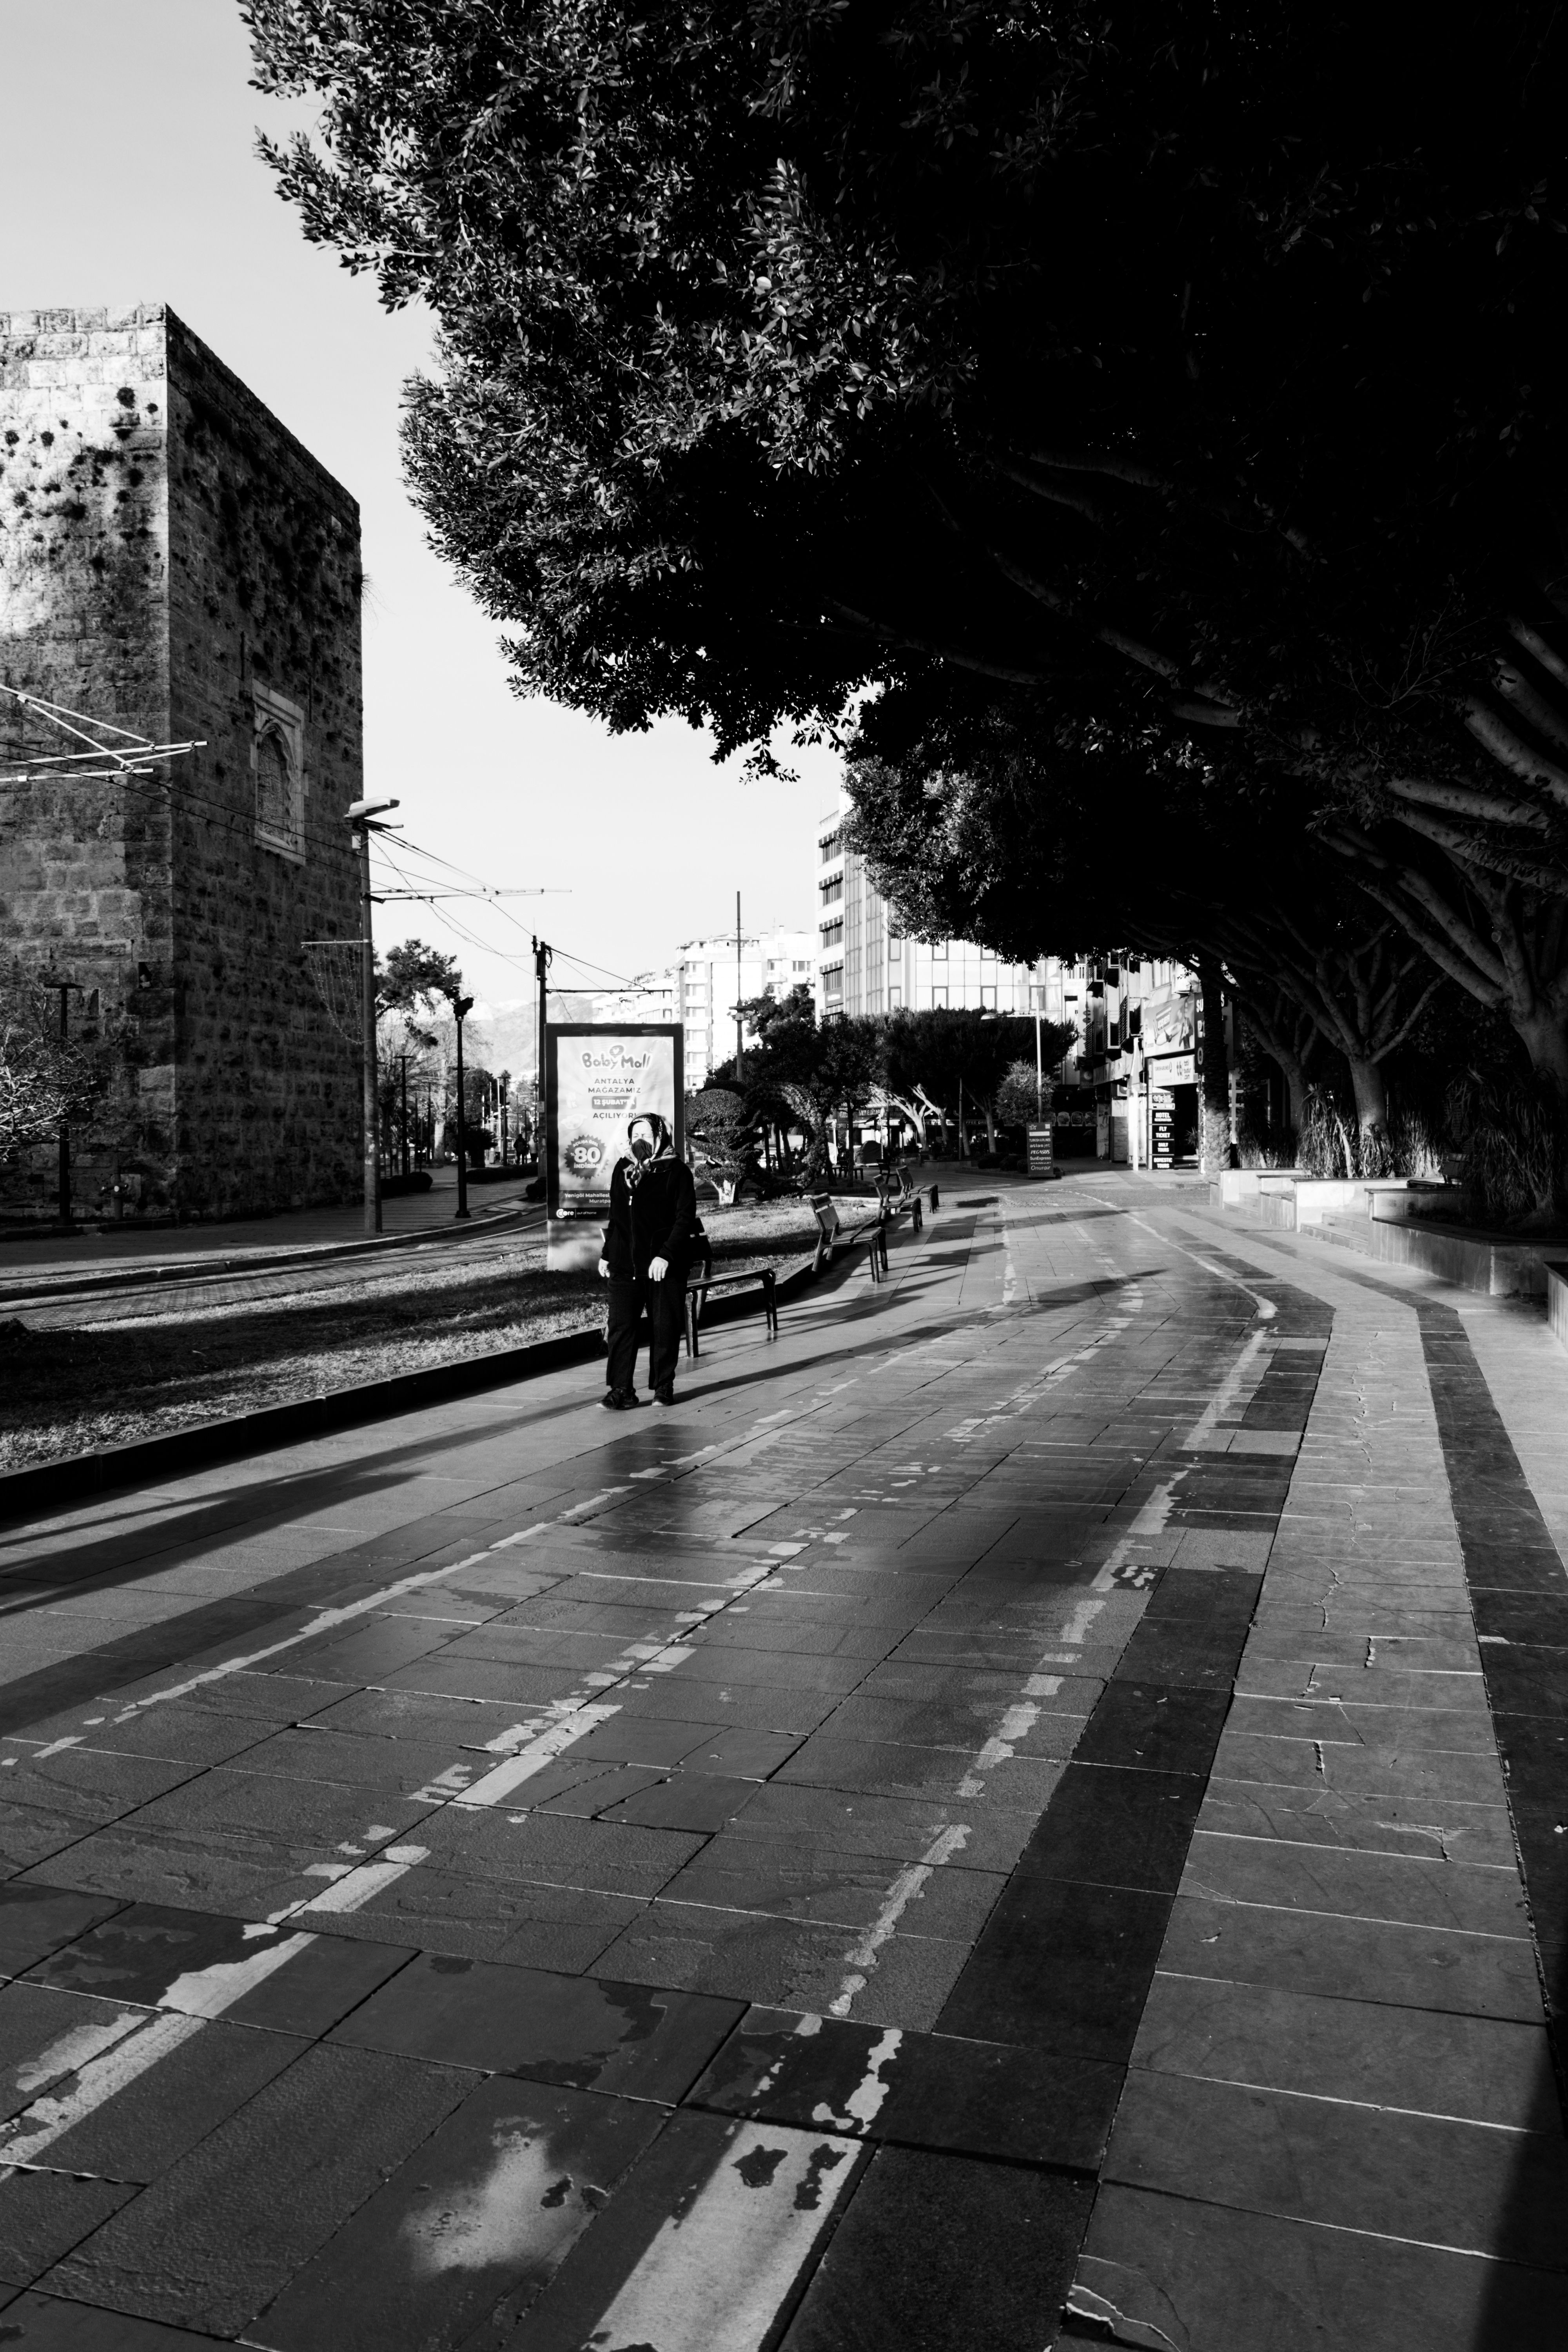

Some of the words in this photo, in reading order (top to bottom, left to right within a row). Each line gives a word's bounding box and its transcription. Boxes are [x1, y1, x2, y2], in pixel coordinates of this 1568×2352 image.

[582, 1052, 618, 1070] Baby
[621, 1053, 651, 1069] Mall
[573, 1139, 588, 1147] AÇILIŞA
